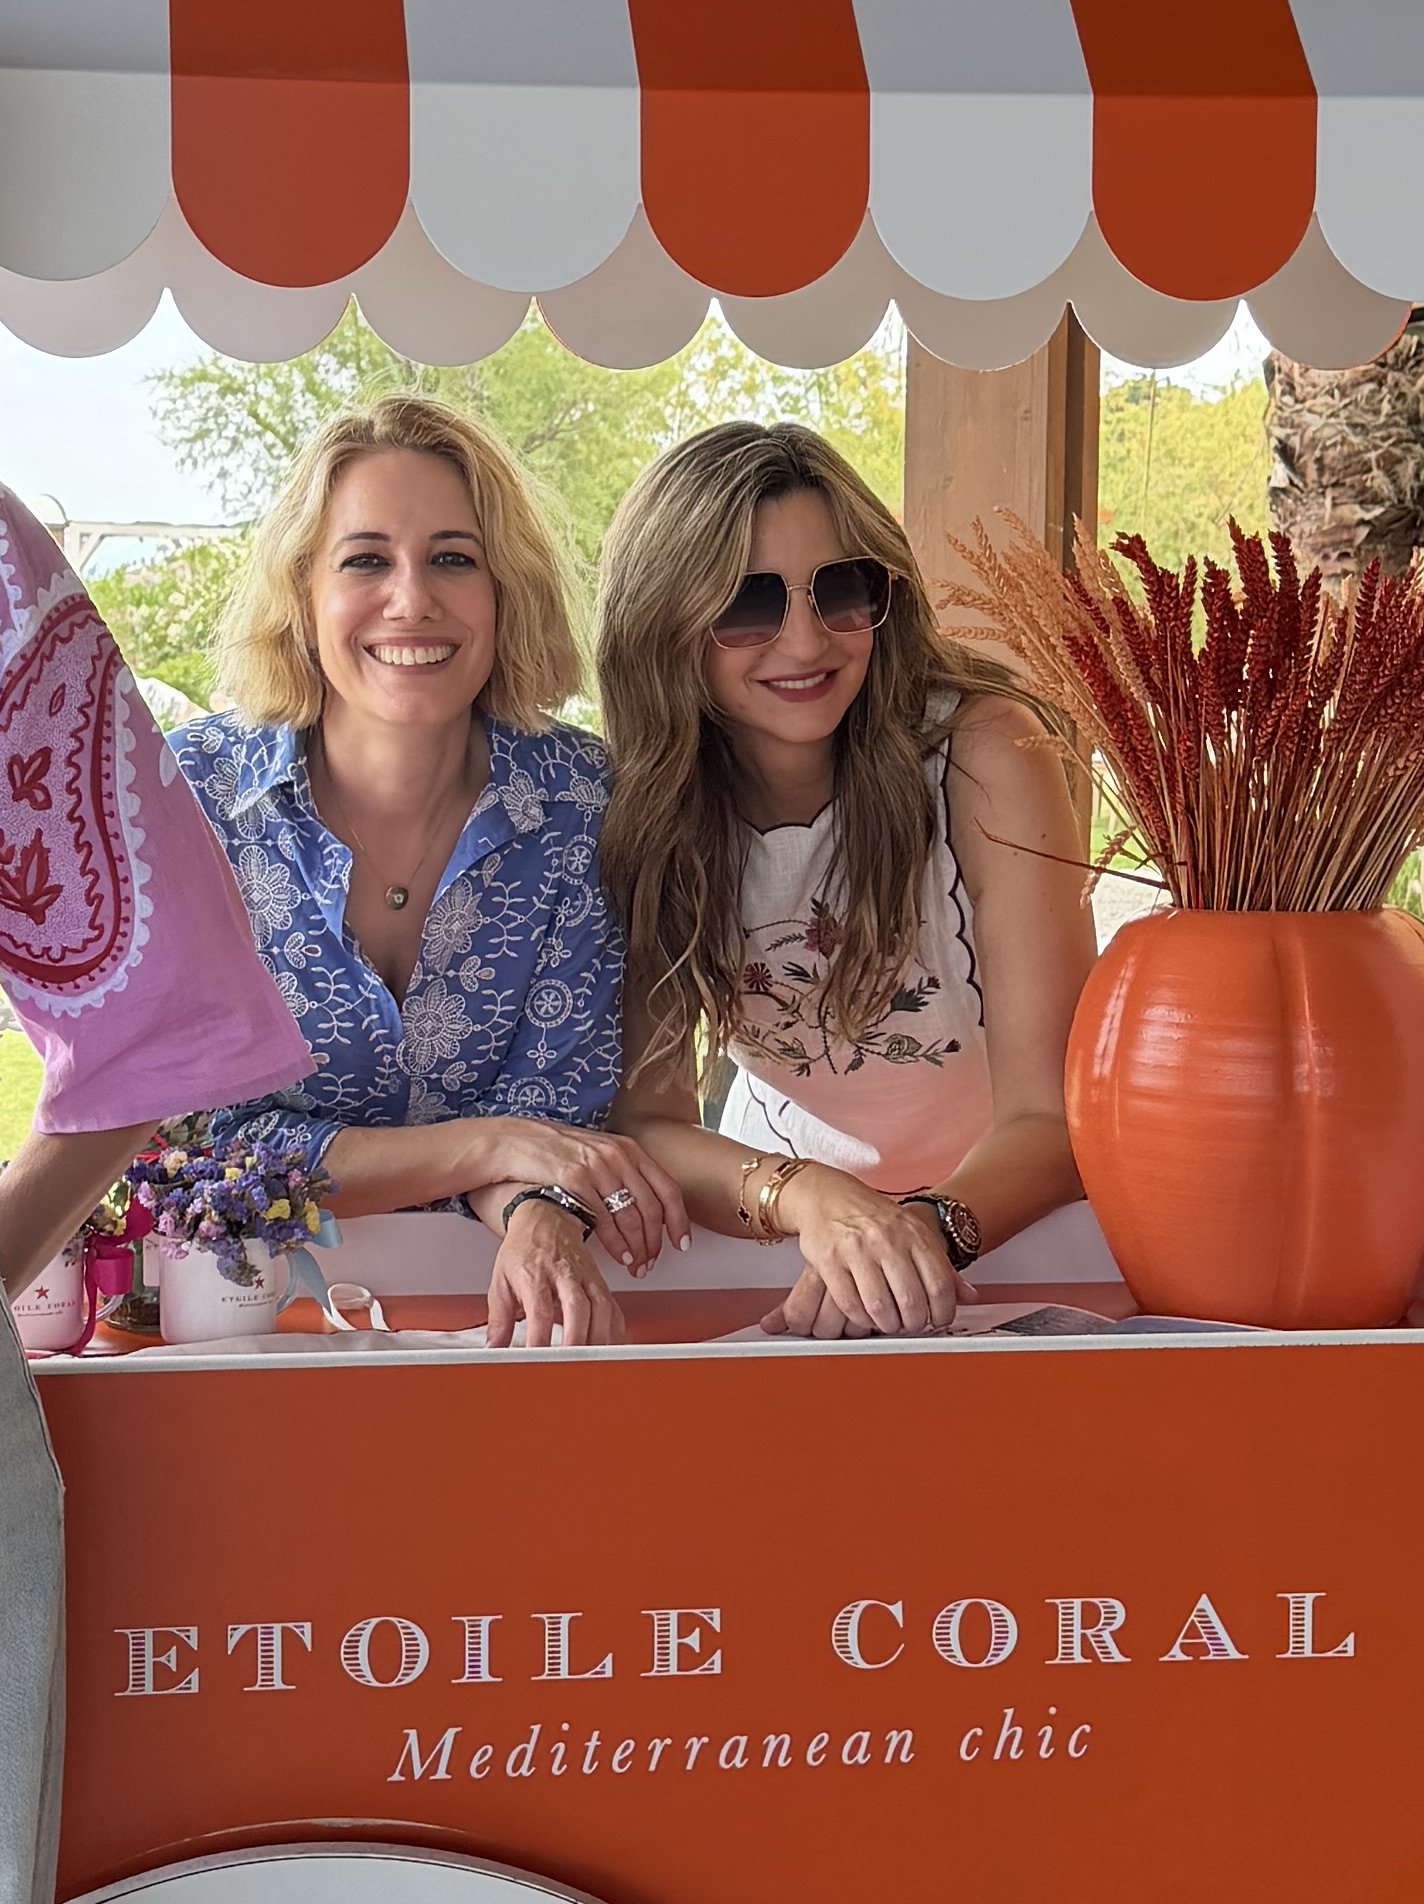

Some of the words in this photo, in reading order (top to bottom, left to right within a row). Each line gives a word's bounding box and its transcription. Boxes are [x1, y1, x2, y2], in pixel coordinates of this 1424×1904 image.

[113, 1607, 723, 1697] ETOILE
[830, 1592, 1356, 1669] CORAL
[385, 1722, 916, 1783] Mediterranean
[958, 1706, 1092, 1762] chic
